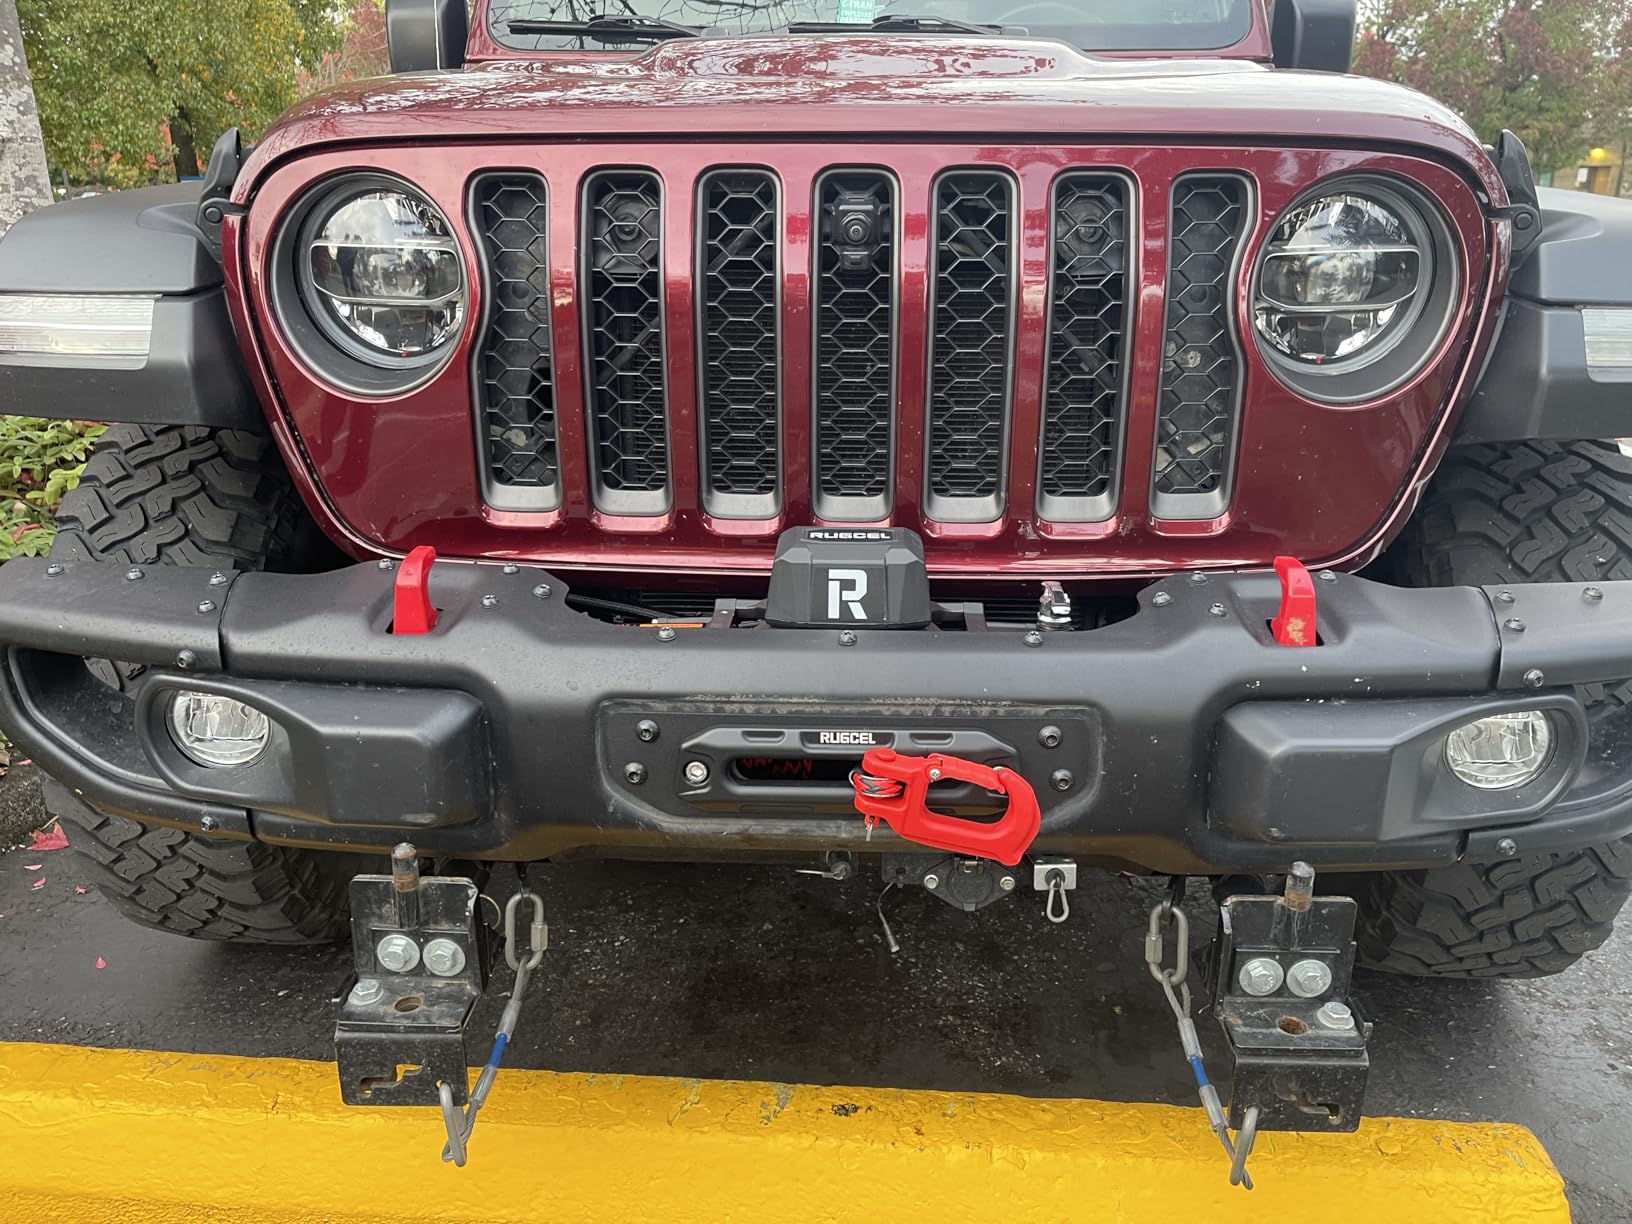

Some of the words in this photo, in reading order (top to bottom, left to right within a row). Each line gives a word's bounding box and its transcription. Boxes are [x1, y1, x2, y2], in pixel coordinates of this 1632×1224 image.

[841, 0, 873, 9] C-TRAN
[809, 531, 891, 540] RUGCEL
[828, 569, 867, 619] R
[820, 732, 876, 744] RUGCEL
